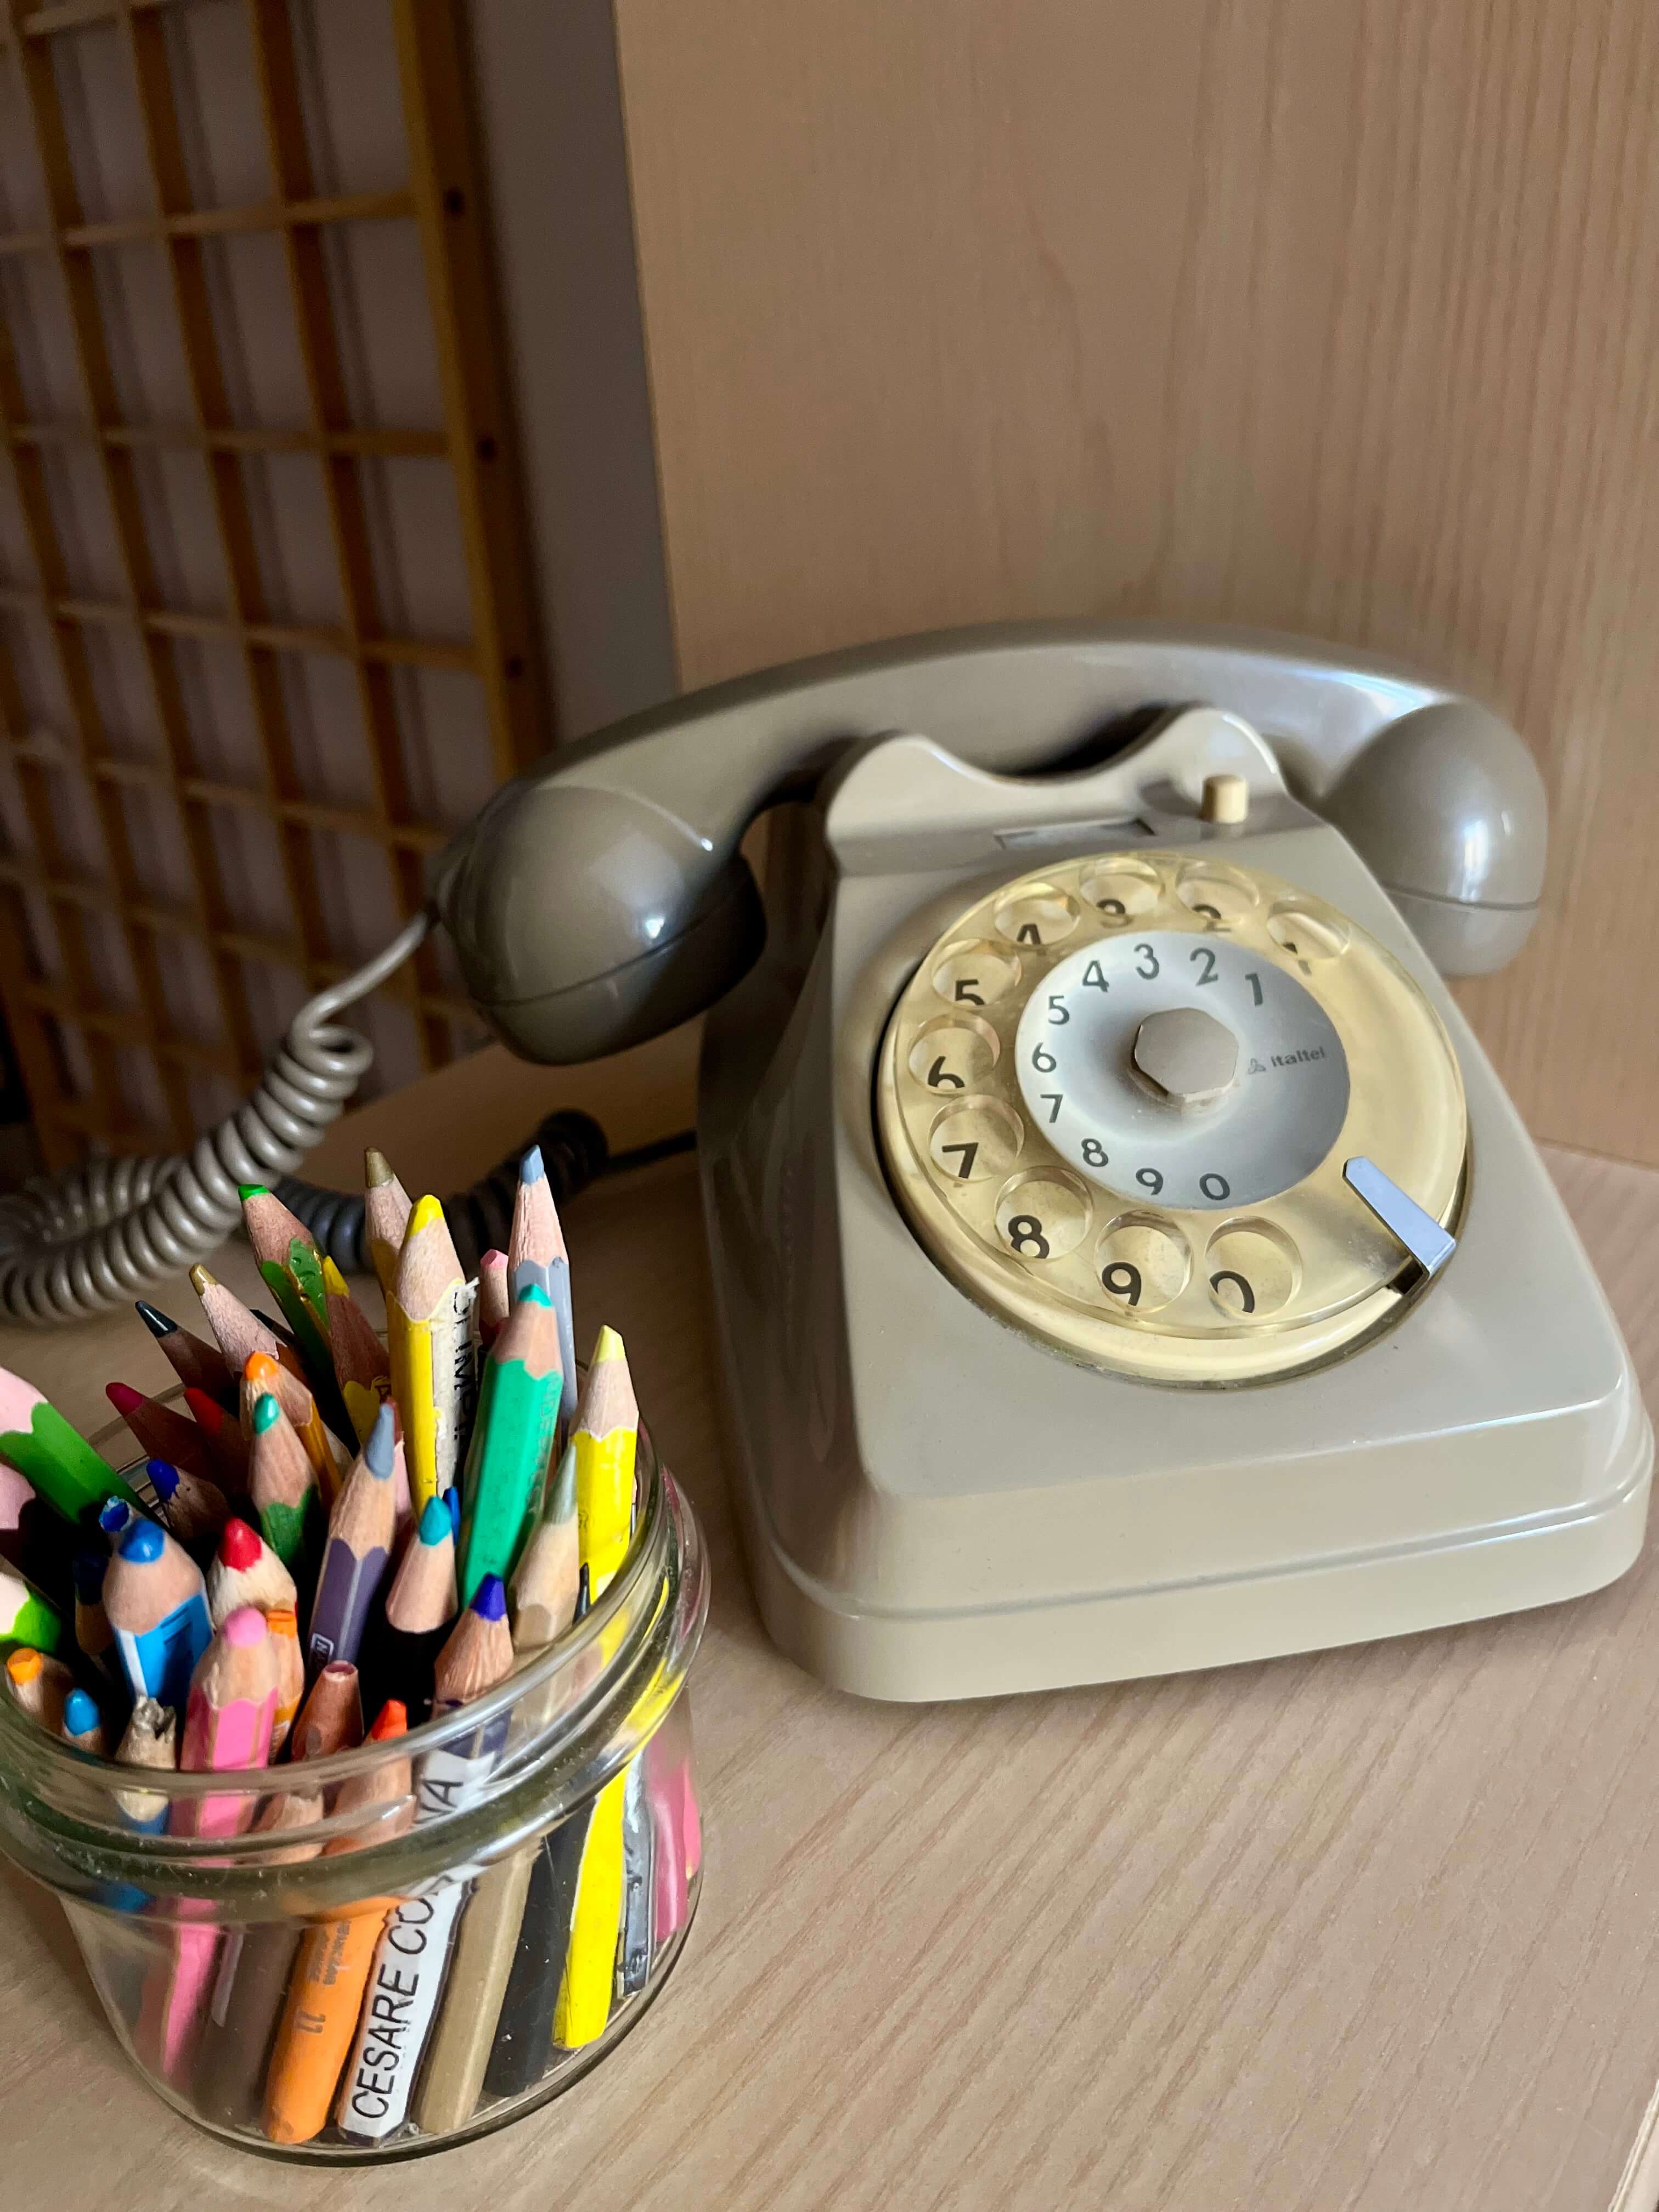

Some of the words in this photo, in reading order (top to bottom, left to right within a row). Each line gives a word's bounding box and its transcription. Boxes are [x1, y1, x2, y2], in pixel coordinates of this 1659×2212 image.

[1081, 960, 1110, 993] 4
[1133, 943, 1160, 980] 3
[1189, 947, 1219, 986] 2
[955, 978, 985, 1006] 5
[1245, 972, 1263, 1007] 1
[1048, 995, 1070, 1025] 5
[927, 1056, 965, 1089] 6
[1031, 1042, 1057, 1073] 6
[1040, 1093, 1064, 1124] 7
[941, 1142, 979, 1180] 7
[1080, 1138, 1109, 1167] 8
[1135, 1167, 1164, 1195] 9
[1199, 1172, 1231, 1200] 0
[1008, 1214, 1050, 1259] 8
[1101, 1261, 1142, 1307] 9
[351, 1963, 419, 2118] CESARE
